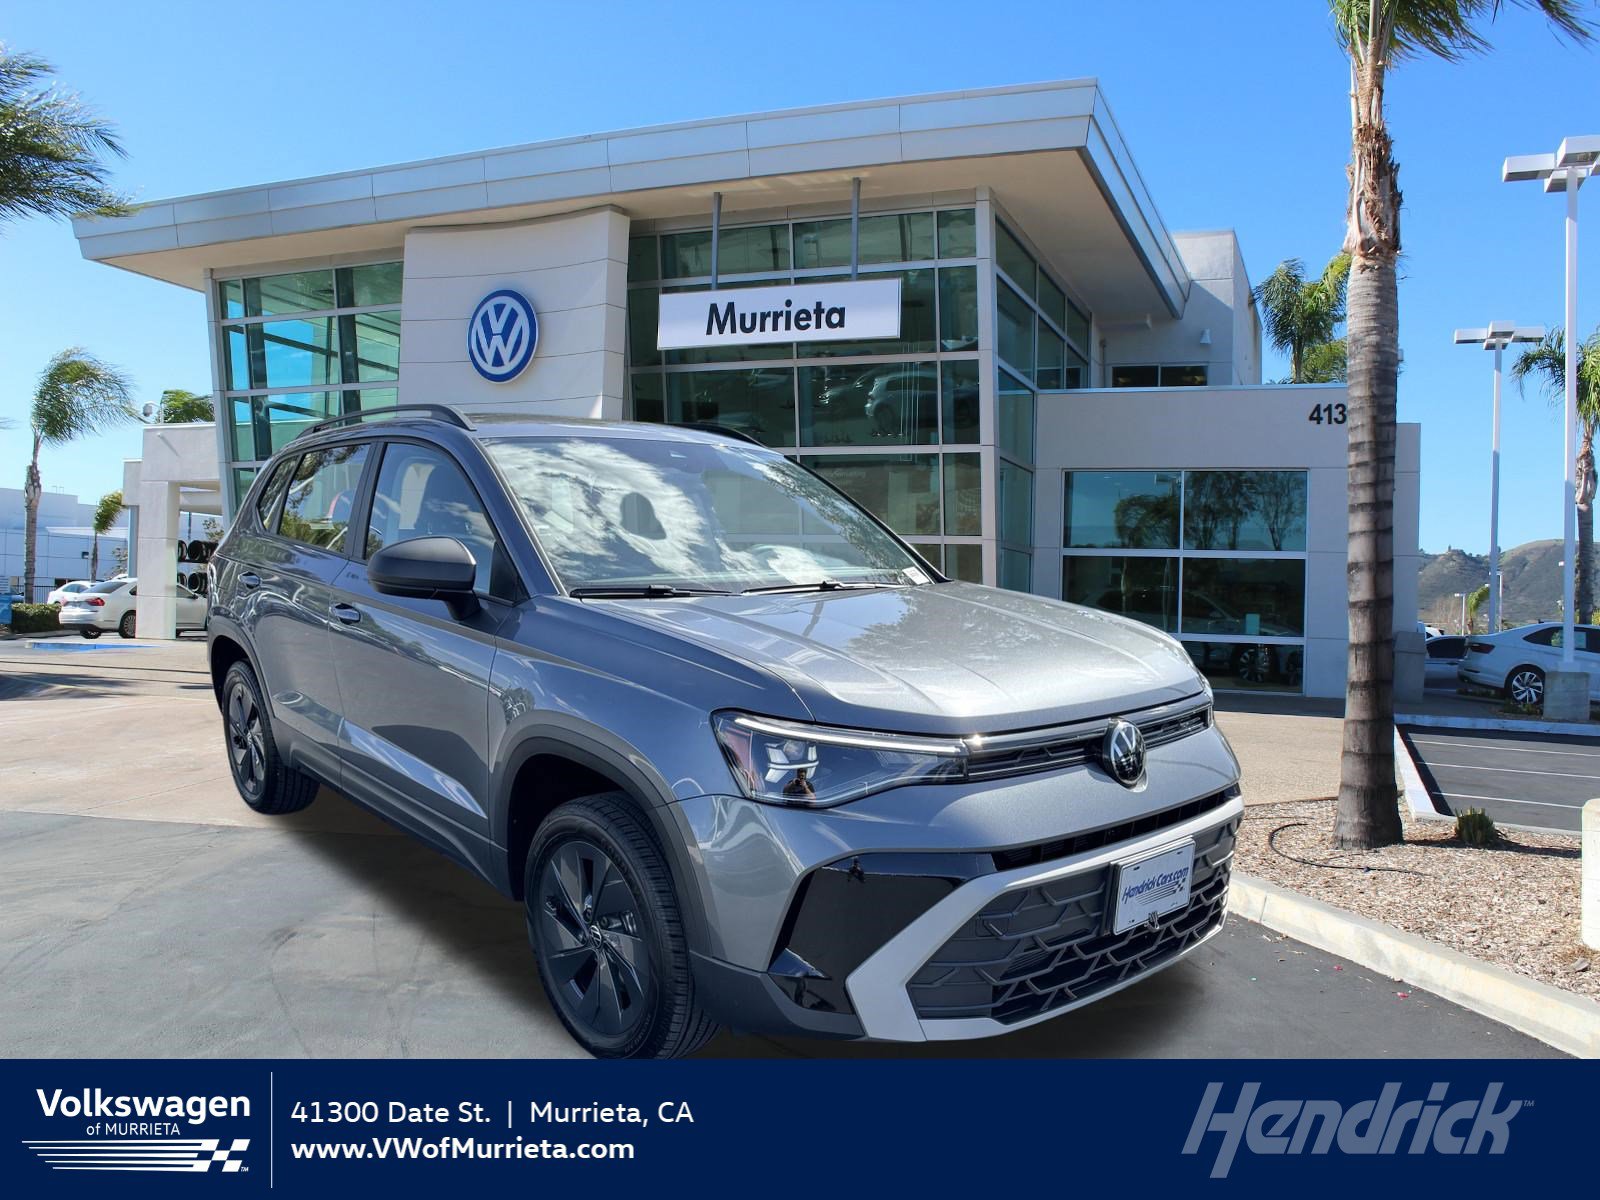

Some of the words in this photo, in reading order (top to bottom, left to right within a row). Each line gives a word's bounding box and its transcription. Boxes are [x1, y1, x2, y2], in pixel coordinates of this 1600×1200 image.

[472, 294, 535, 377] VW
[706, 300, 846, 336] Murrieta
[1309, 404, 1347, 425] 413
